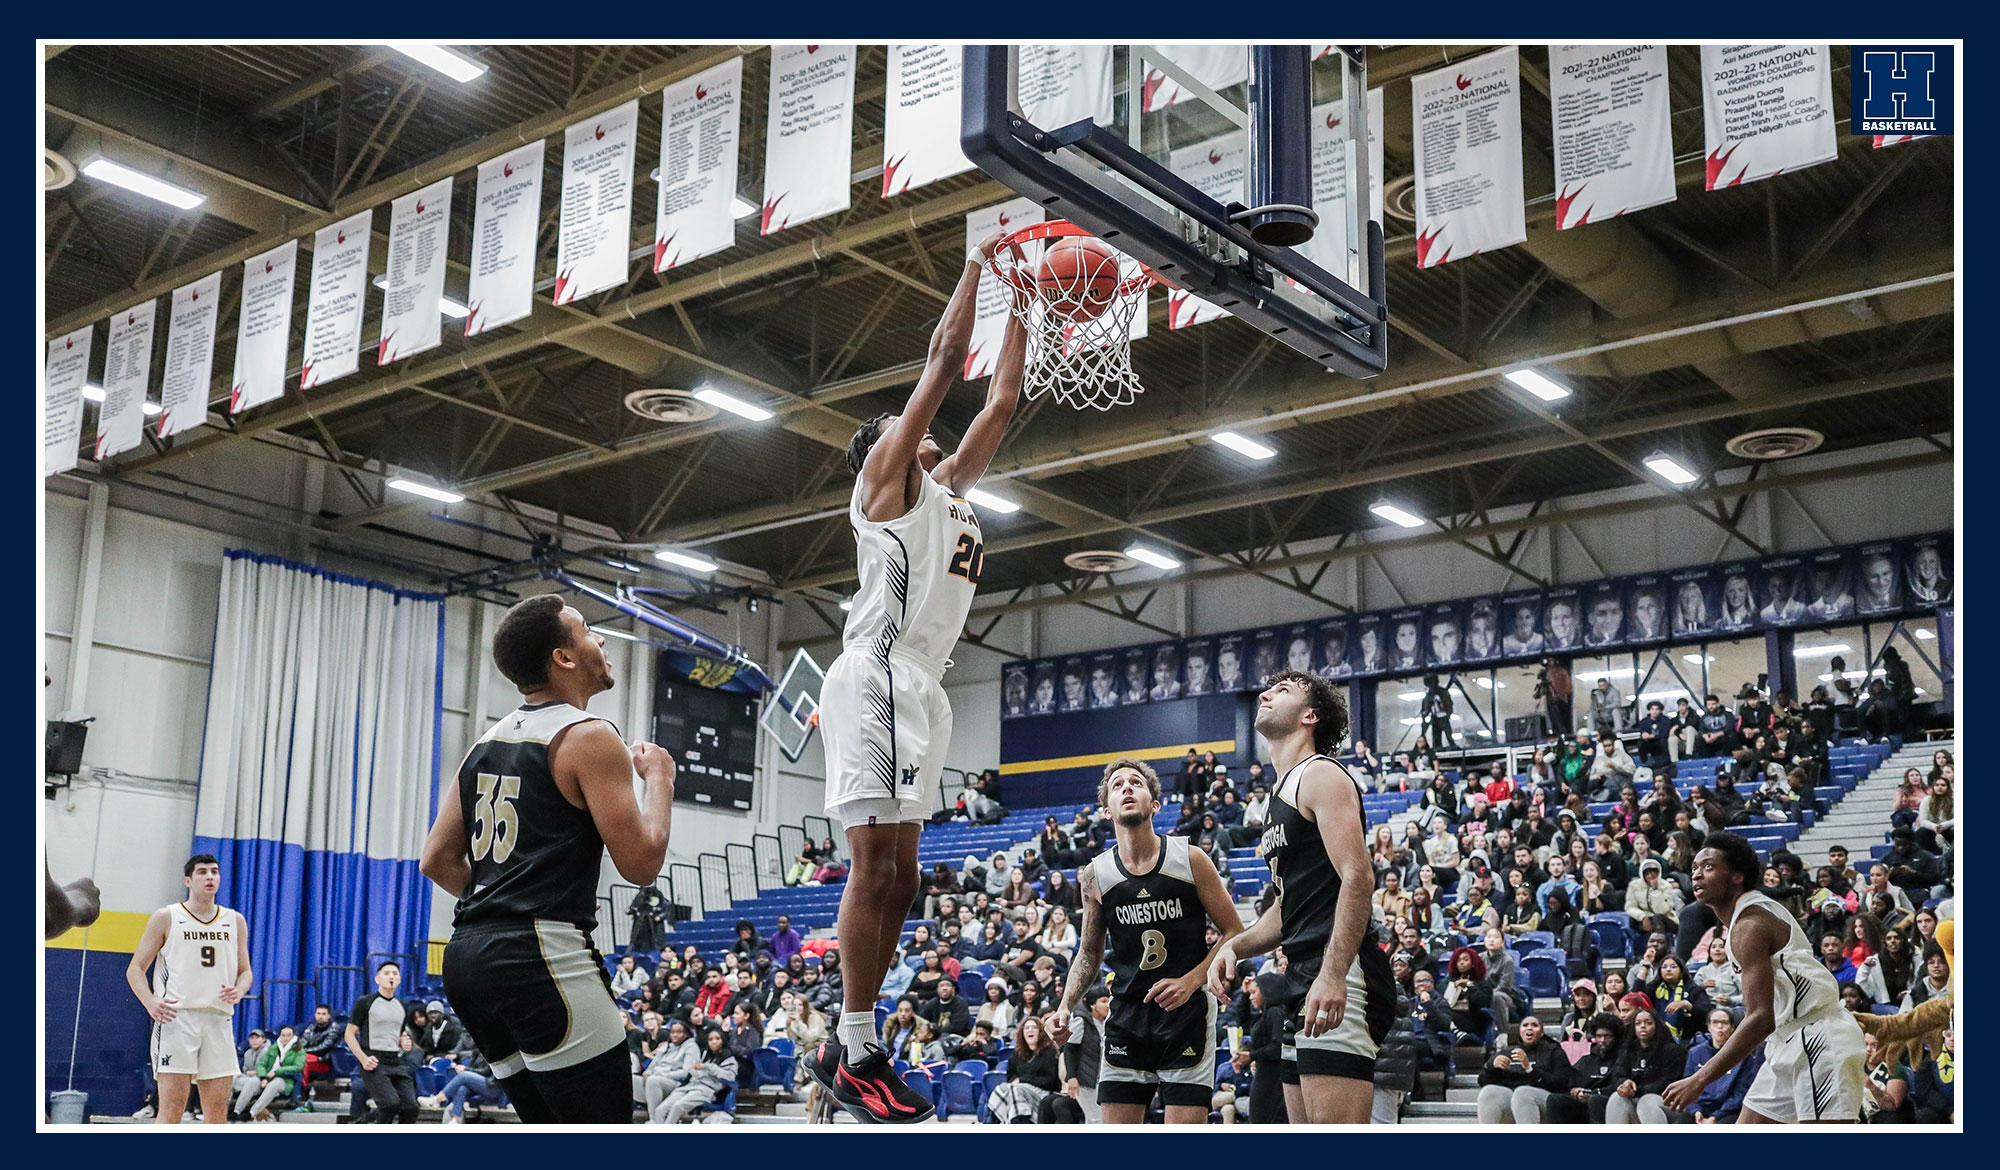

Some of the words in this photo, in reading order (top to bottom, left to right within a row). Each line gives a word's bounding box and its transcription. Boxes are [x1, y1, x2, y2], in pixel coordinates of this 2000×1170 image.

[808, 54, 848, 74] NATIONAL
[1598, 56, 1642, 73] BASKETBALL
[1602, 45, 1654, 63] NATIONAL
[1714, 63, 1756, 81] 2021-22
[1759, 48, 1816, 69] NATIONAL
[812, 70, 846, 88] CHAMPIONS
[1586, 66, 1630, 82] CHAMPIONS
[1717, 79, 1764, 96] BADMINTON
[1767, 65, 1816, 84] CHAMPIONS
[1728, 72, 1765, 86] WOMEN'S
[1767, 60, 1803, 76] DOUBLES
[697, 91, 732, 110] NATIONAL
[1422, 95, 1460, 112] 2022-23
[1461, 80, 1509, 100] NATIONAL
[1443, 102, 1470, 113] SOCCER
[1470, 88, 1511, 106] CHAMPIONS
[1724, 95, 1754, 106] Victoria
[1756, 86, 1784, 99] Duong
[1760, 96, 1784, 108] Taneja
[1726, 114, 1750, 124] Karen
[1752, 110, 1764, 119] Ng
[1766, 104, 1787, 114] Head
[1789, 96, 1816, 108] Coach
[1726, 122, 1749, 134] David
[1794, 104, 1820, 116] Coach
[1805, 108, 1828, 122] Coach
[596, 142, 627, 158] NATIONAL
[948, 532, 984, 586] 20
[902, 768, 916, 786] H
[471, 772, 521, 864] 35
[1116, 898, 1182, 924] CONESTOGA
[184, 931, 230, 942] HUMBER
[201, 946, 216, 968] 9
[1139, 929, 1167, 970] 8
